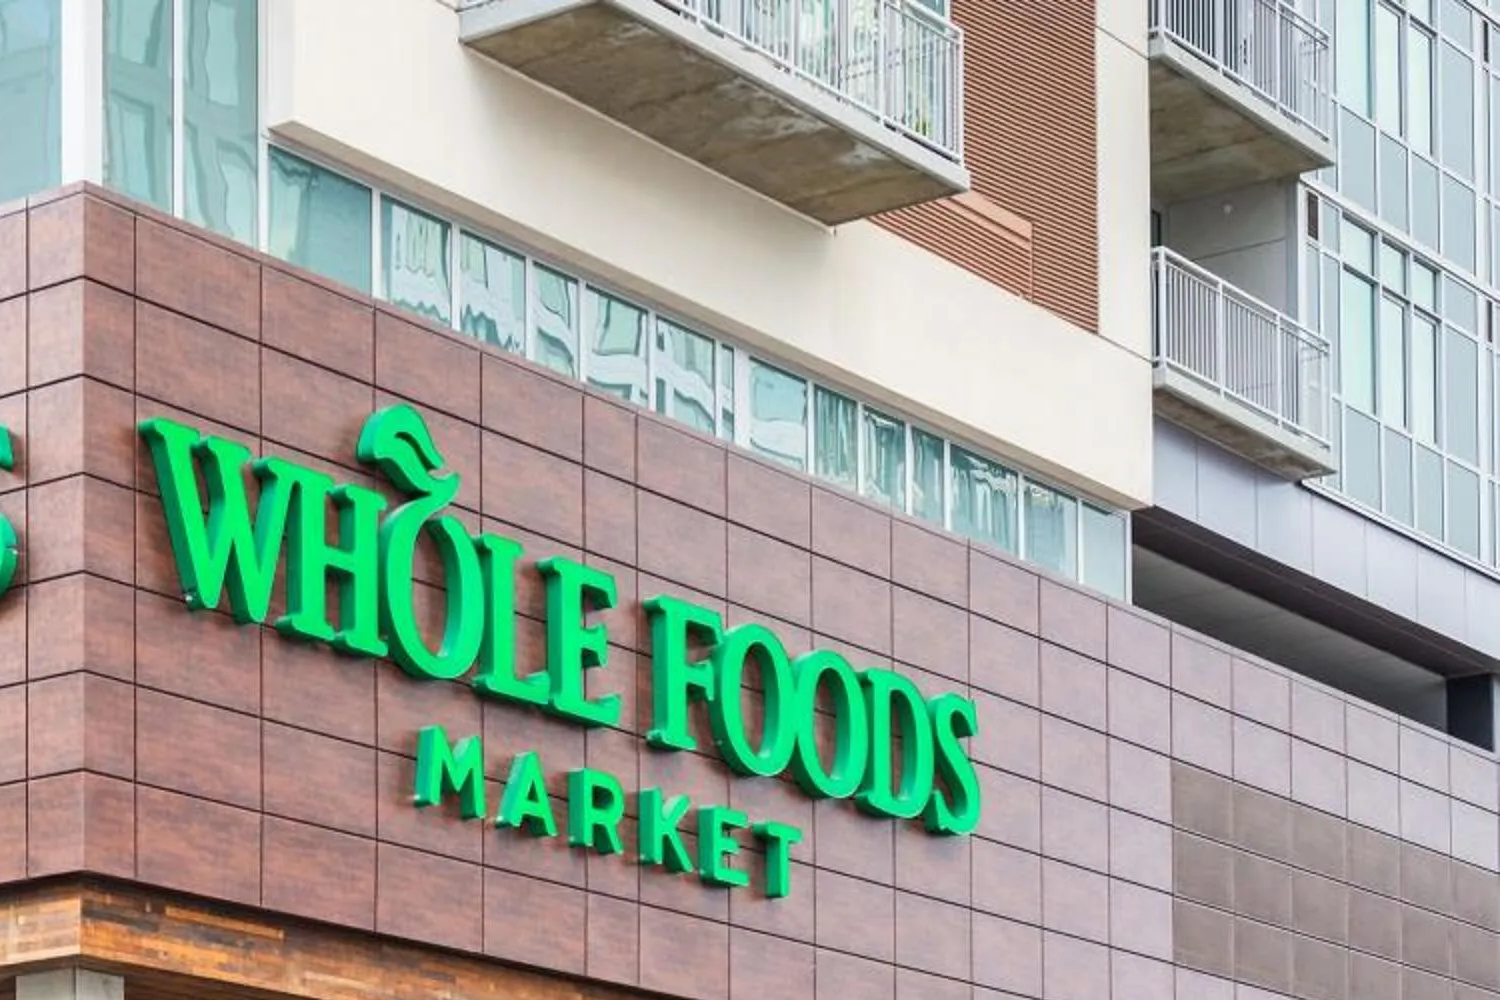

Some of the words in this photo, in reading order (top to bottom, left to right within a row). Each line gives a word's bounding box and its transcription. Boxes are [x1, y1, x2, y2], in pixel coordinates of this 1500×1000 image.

[137, 404, 622, 727] WHOLE
[644, 595, 980, 836] FOODS
[413, 725, 804, 898] MARKET
